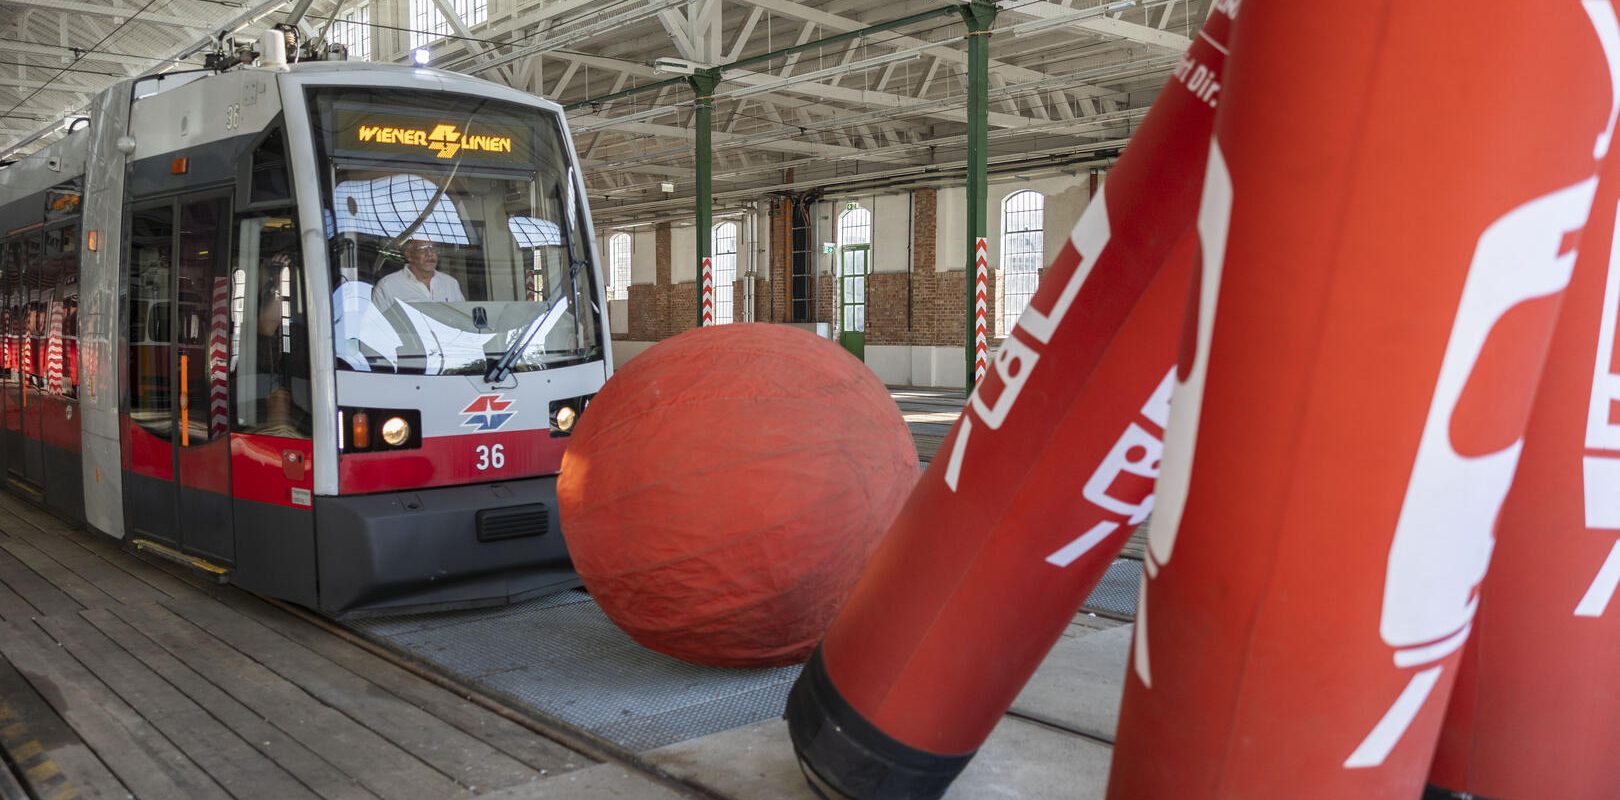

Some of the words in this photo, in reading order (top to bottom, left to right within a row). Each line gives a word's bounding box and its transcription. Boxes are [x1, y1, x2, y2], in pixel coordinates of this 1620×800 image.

[1187, 64, 1221, 108] Dir.
[226, 104, 239, 129] 36
[358, 125, 429, 147] WIENER
[460, 135, 512, 152] LINIEN
[475, 443, 505, 471] 36
